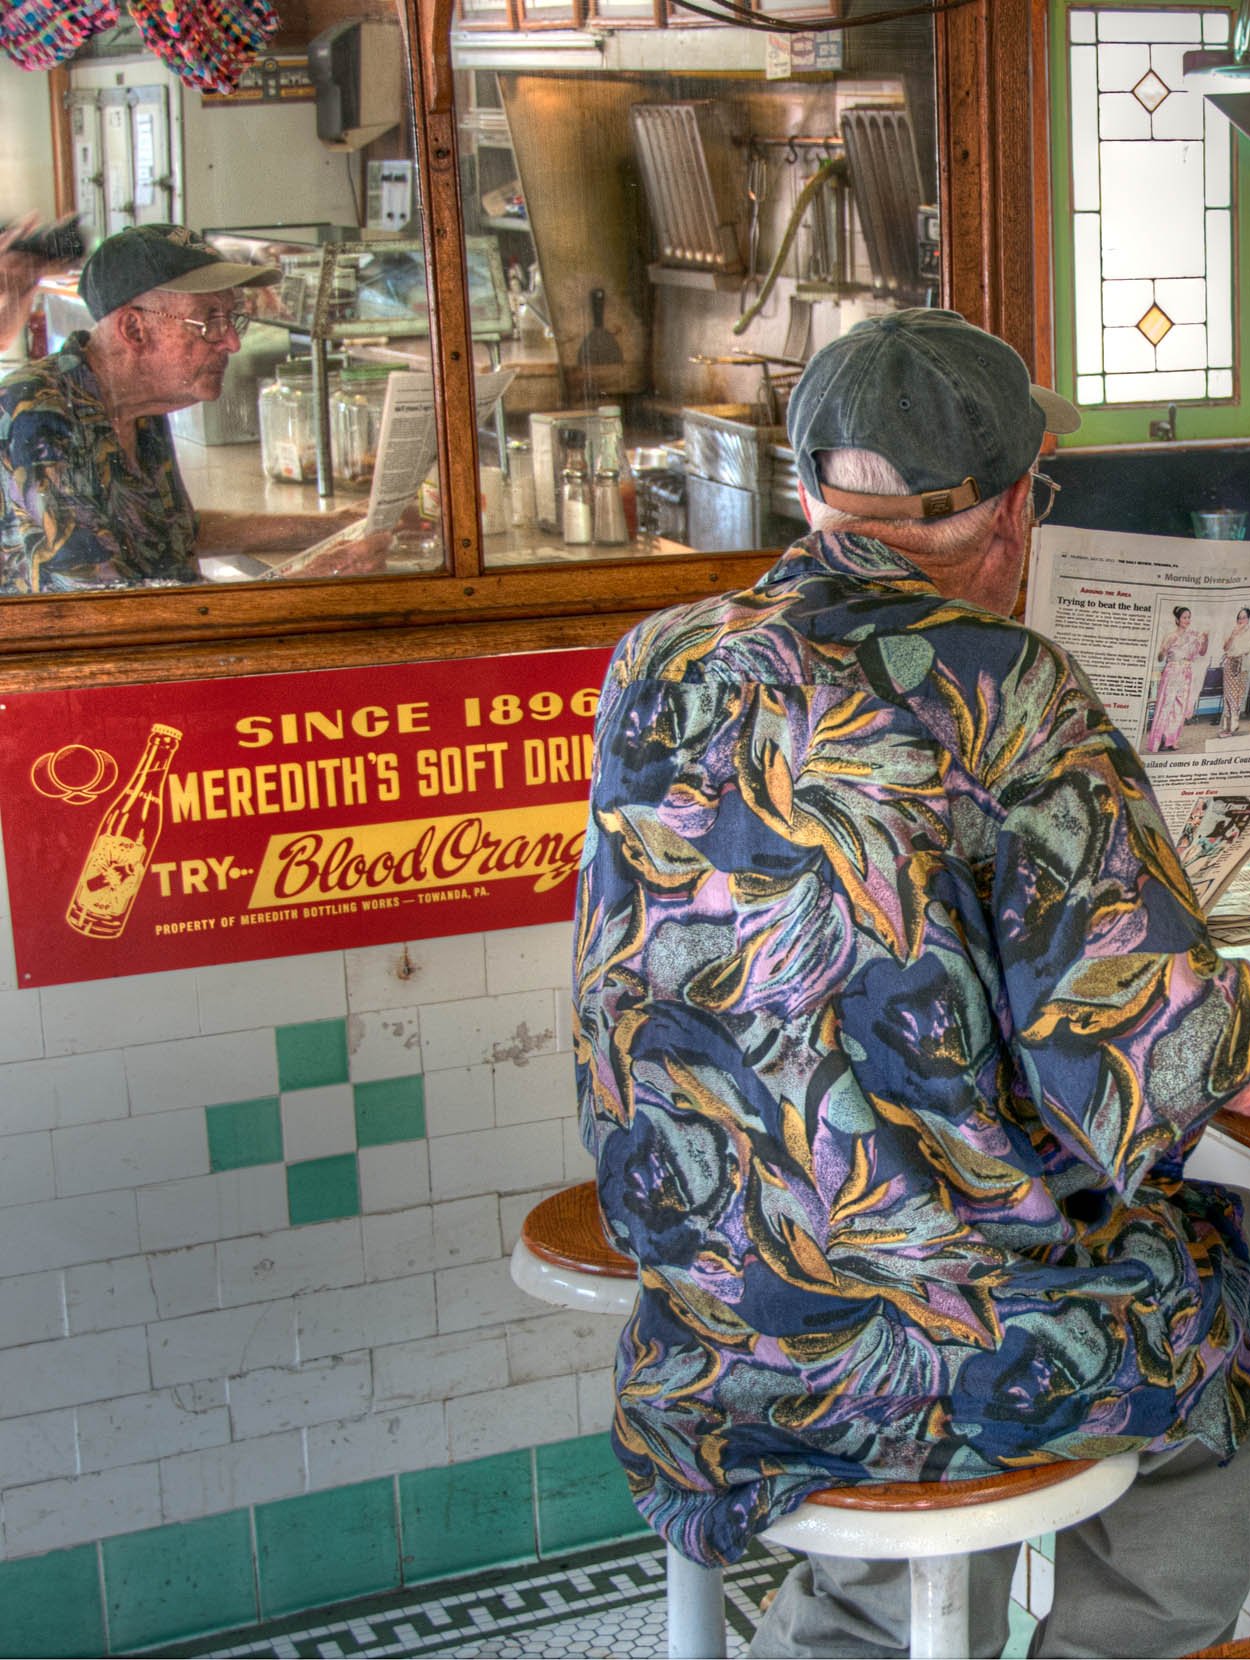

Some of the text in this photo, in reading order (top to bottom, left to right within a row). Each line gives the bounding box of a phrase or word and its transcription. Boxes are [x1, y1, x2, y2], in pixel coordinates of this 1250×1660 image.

[1165, 573, 1241, 584] Morning Diversion
[1057, 596, 1152, 612] Trying to beat the heat
[235, 687, 600, 748] SINCE 1896
[168, 752, 400, 823] MEREDITH'S
[417, 742, 509, 797] SOFT
[1143, 760, 1168, 769] ailand
[1201, 757, 1232, 767] Bradford
[274, 820, 436, 899] Blood
[155, 886, 490, 936] PROPERTY OF MEREDITH BOTTLING WORKS TOWANDA, PA.
